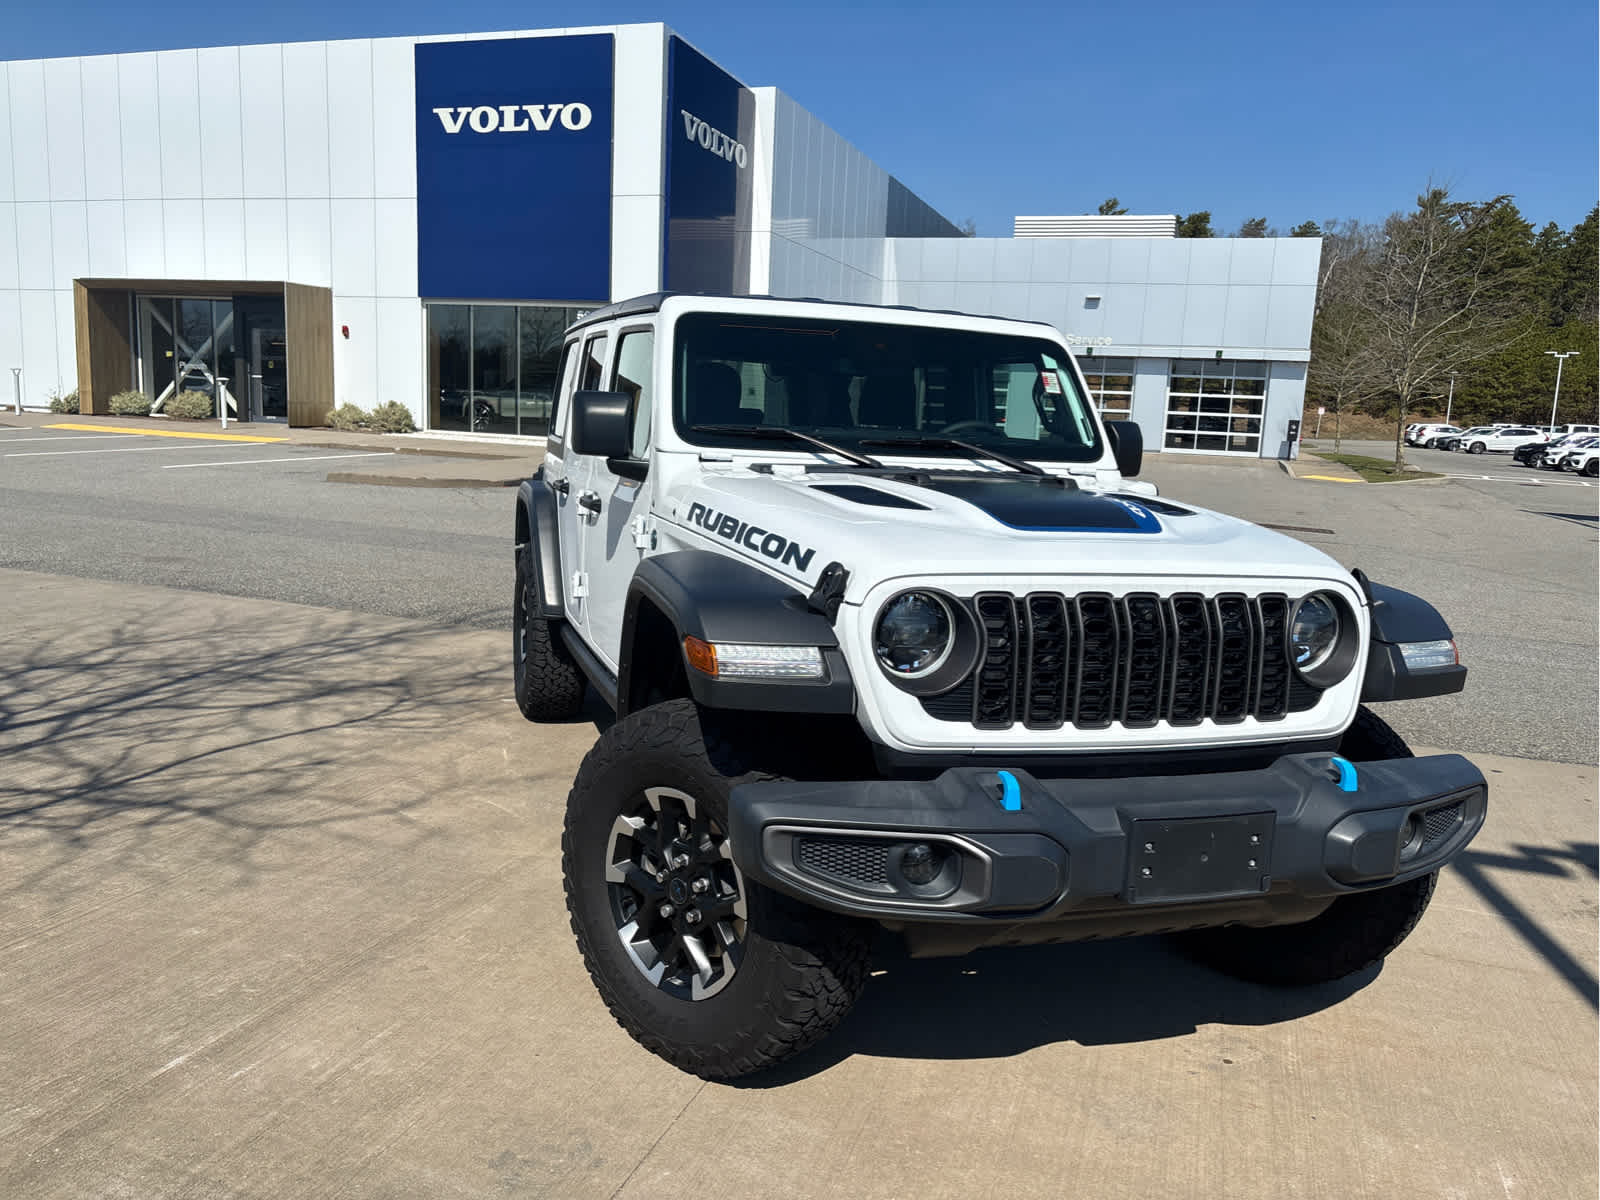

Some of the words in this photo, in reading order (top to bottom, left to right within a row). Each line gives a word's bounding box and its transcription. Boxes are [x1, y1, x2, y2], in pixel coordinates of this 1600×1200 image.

[432, 102, 593, 134] VOLVO
[681, 109, 747, 169] VOLVO
[1065, 333, 1112, 346] Service
[686, 501, 817, 573] RUBICON
